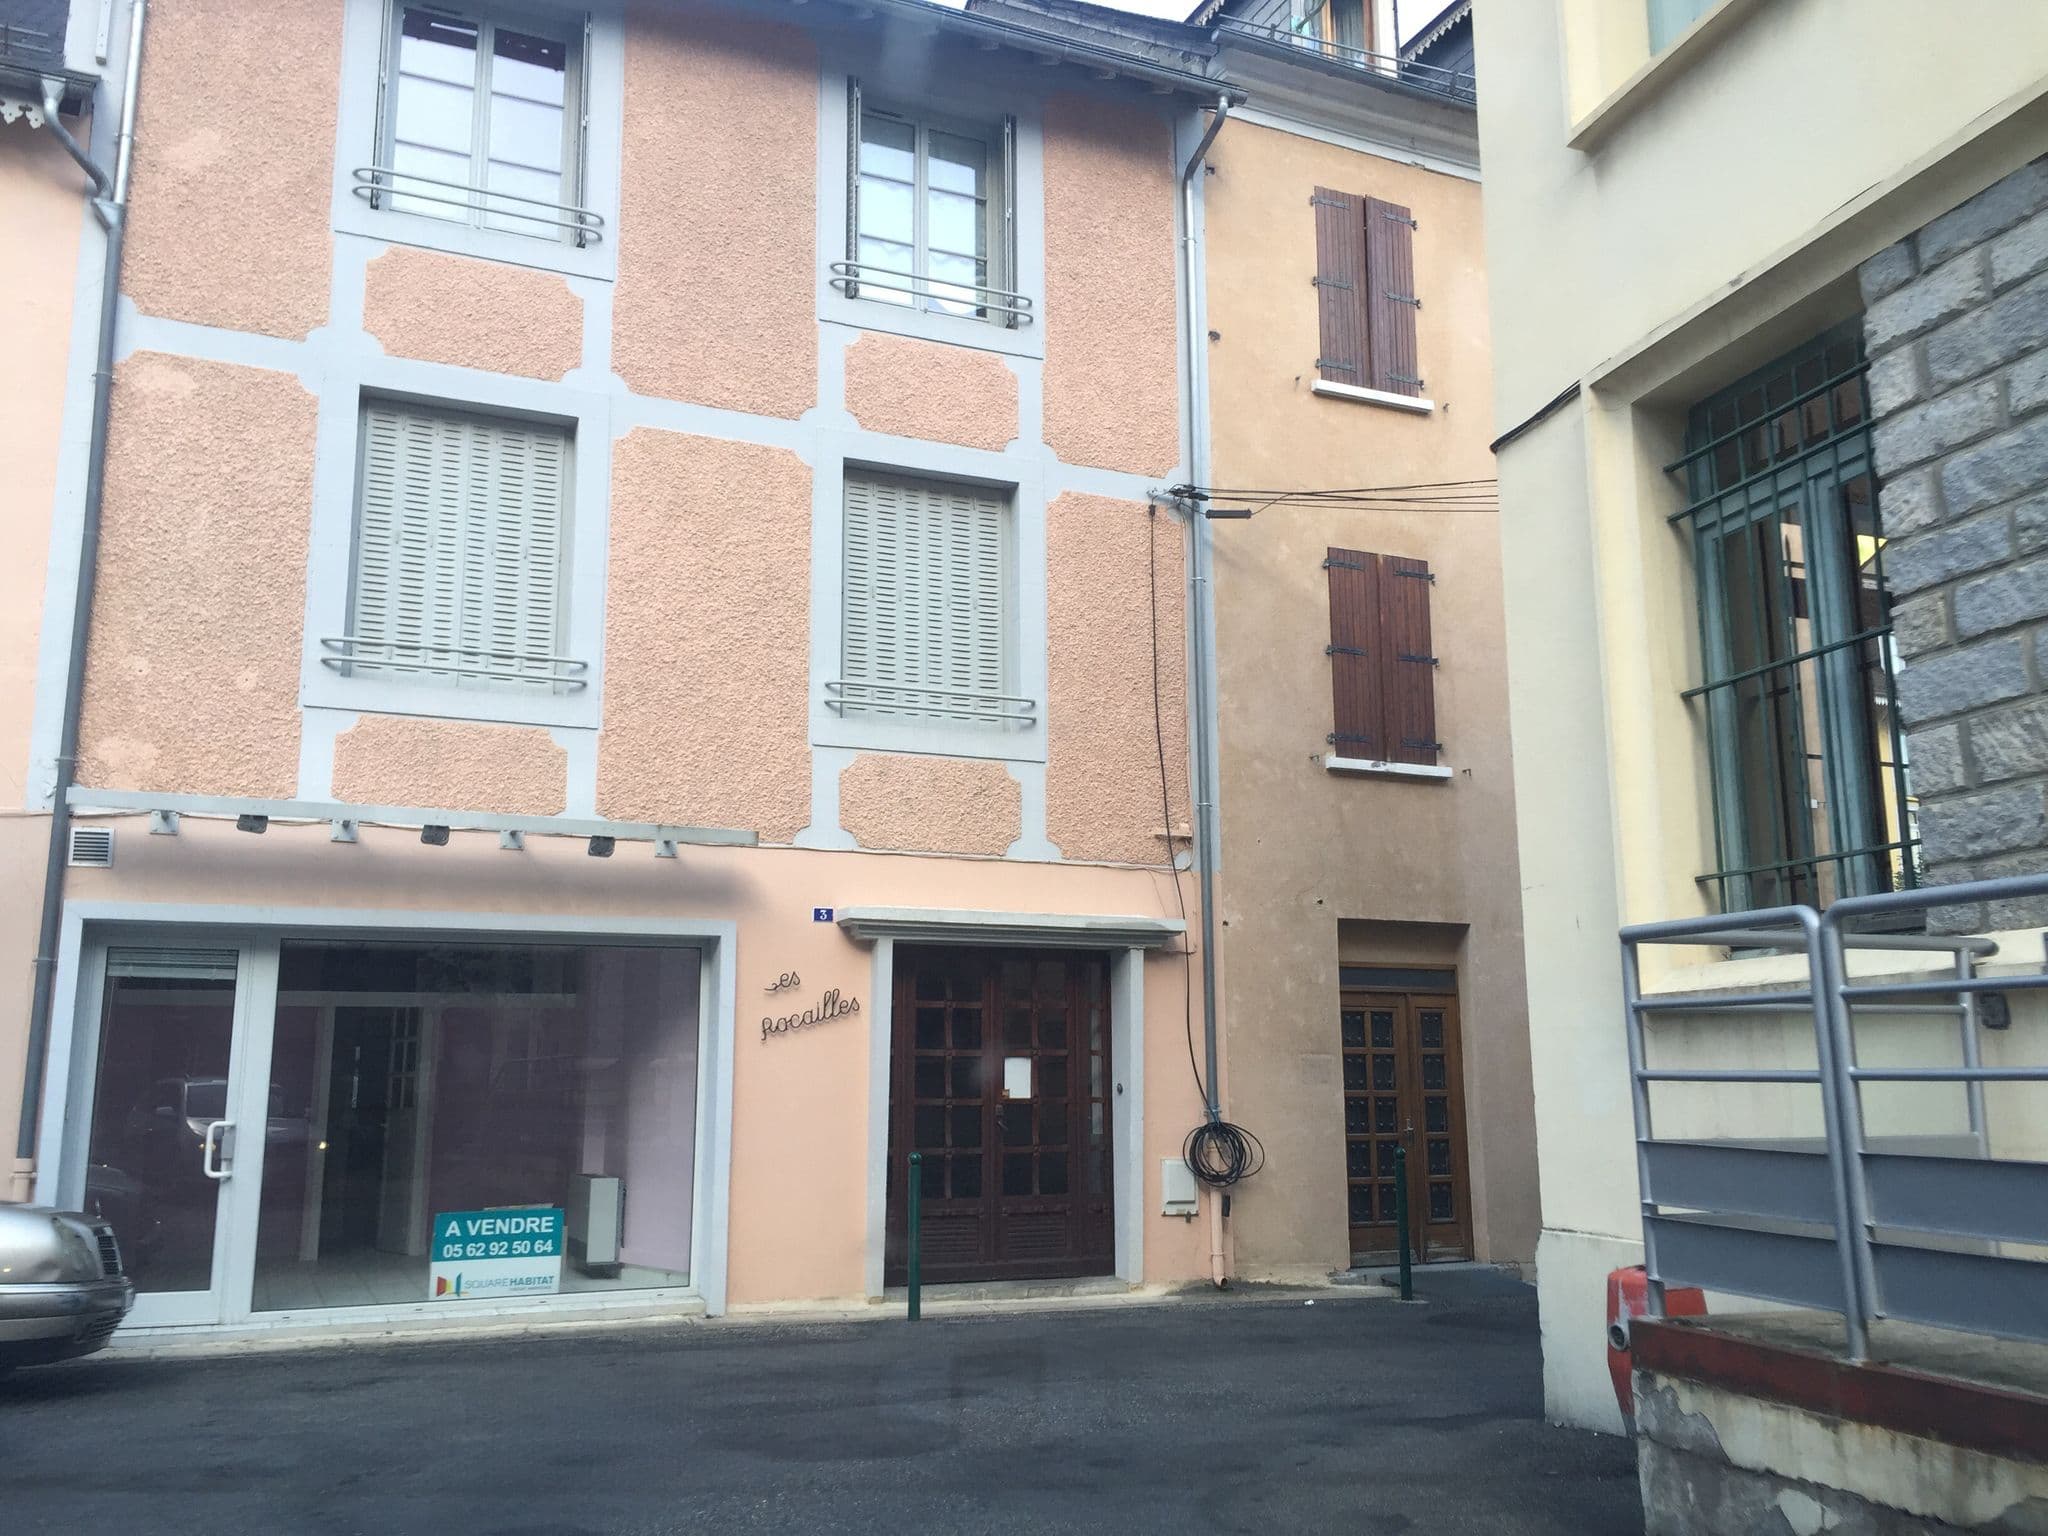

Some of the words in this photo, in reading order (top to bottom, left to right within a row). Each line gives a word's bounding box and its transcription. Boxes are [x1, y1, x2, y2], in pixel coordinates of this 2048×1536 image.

[820, 909, 828, 921] 3
[445, 1220, 461, 1237] A
[467, 1216, 555, 1236] VENDRE
[443, 1244, 463, 1258] 05
[466, 1242, 486, 1256] 62
[489, 1241, 508, 1255] 92
[512, 1240, 531, 1254] 50
[534, 1239, 553, 1253] 64
